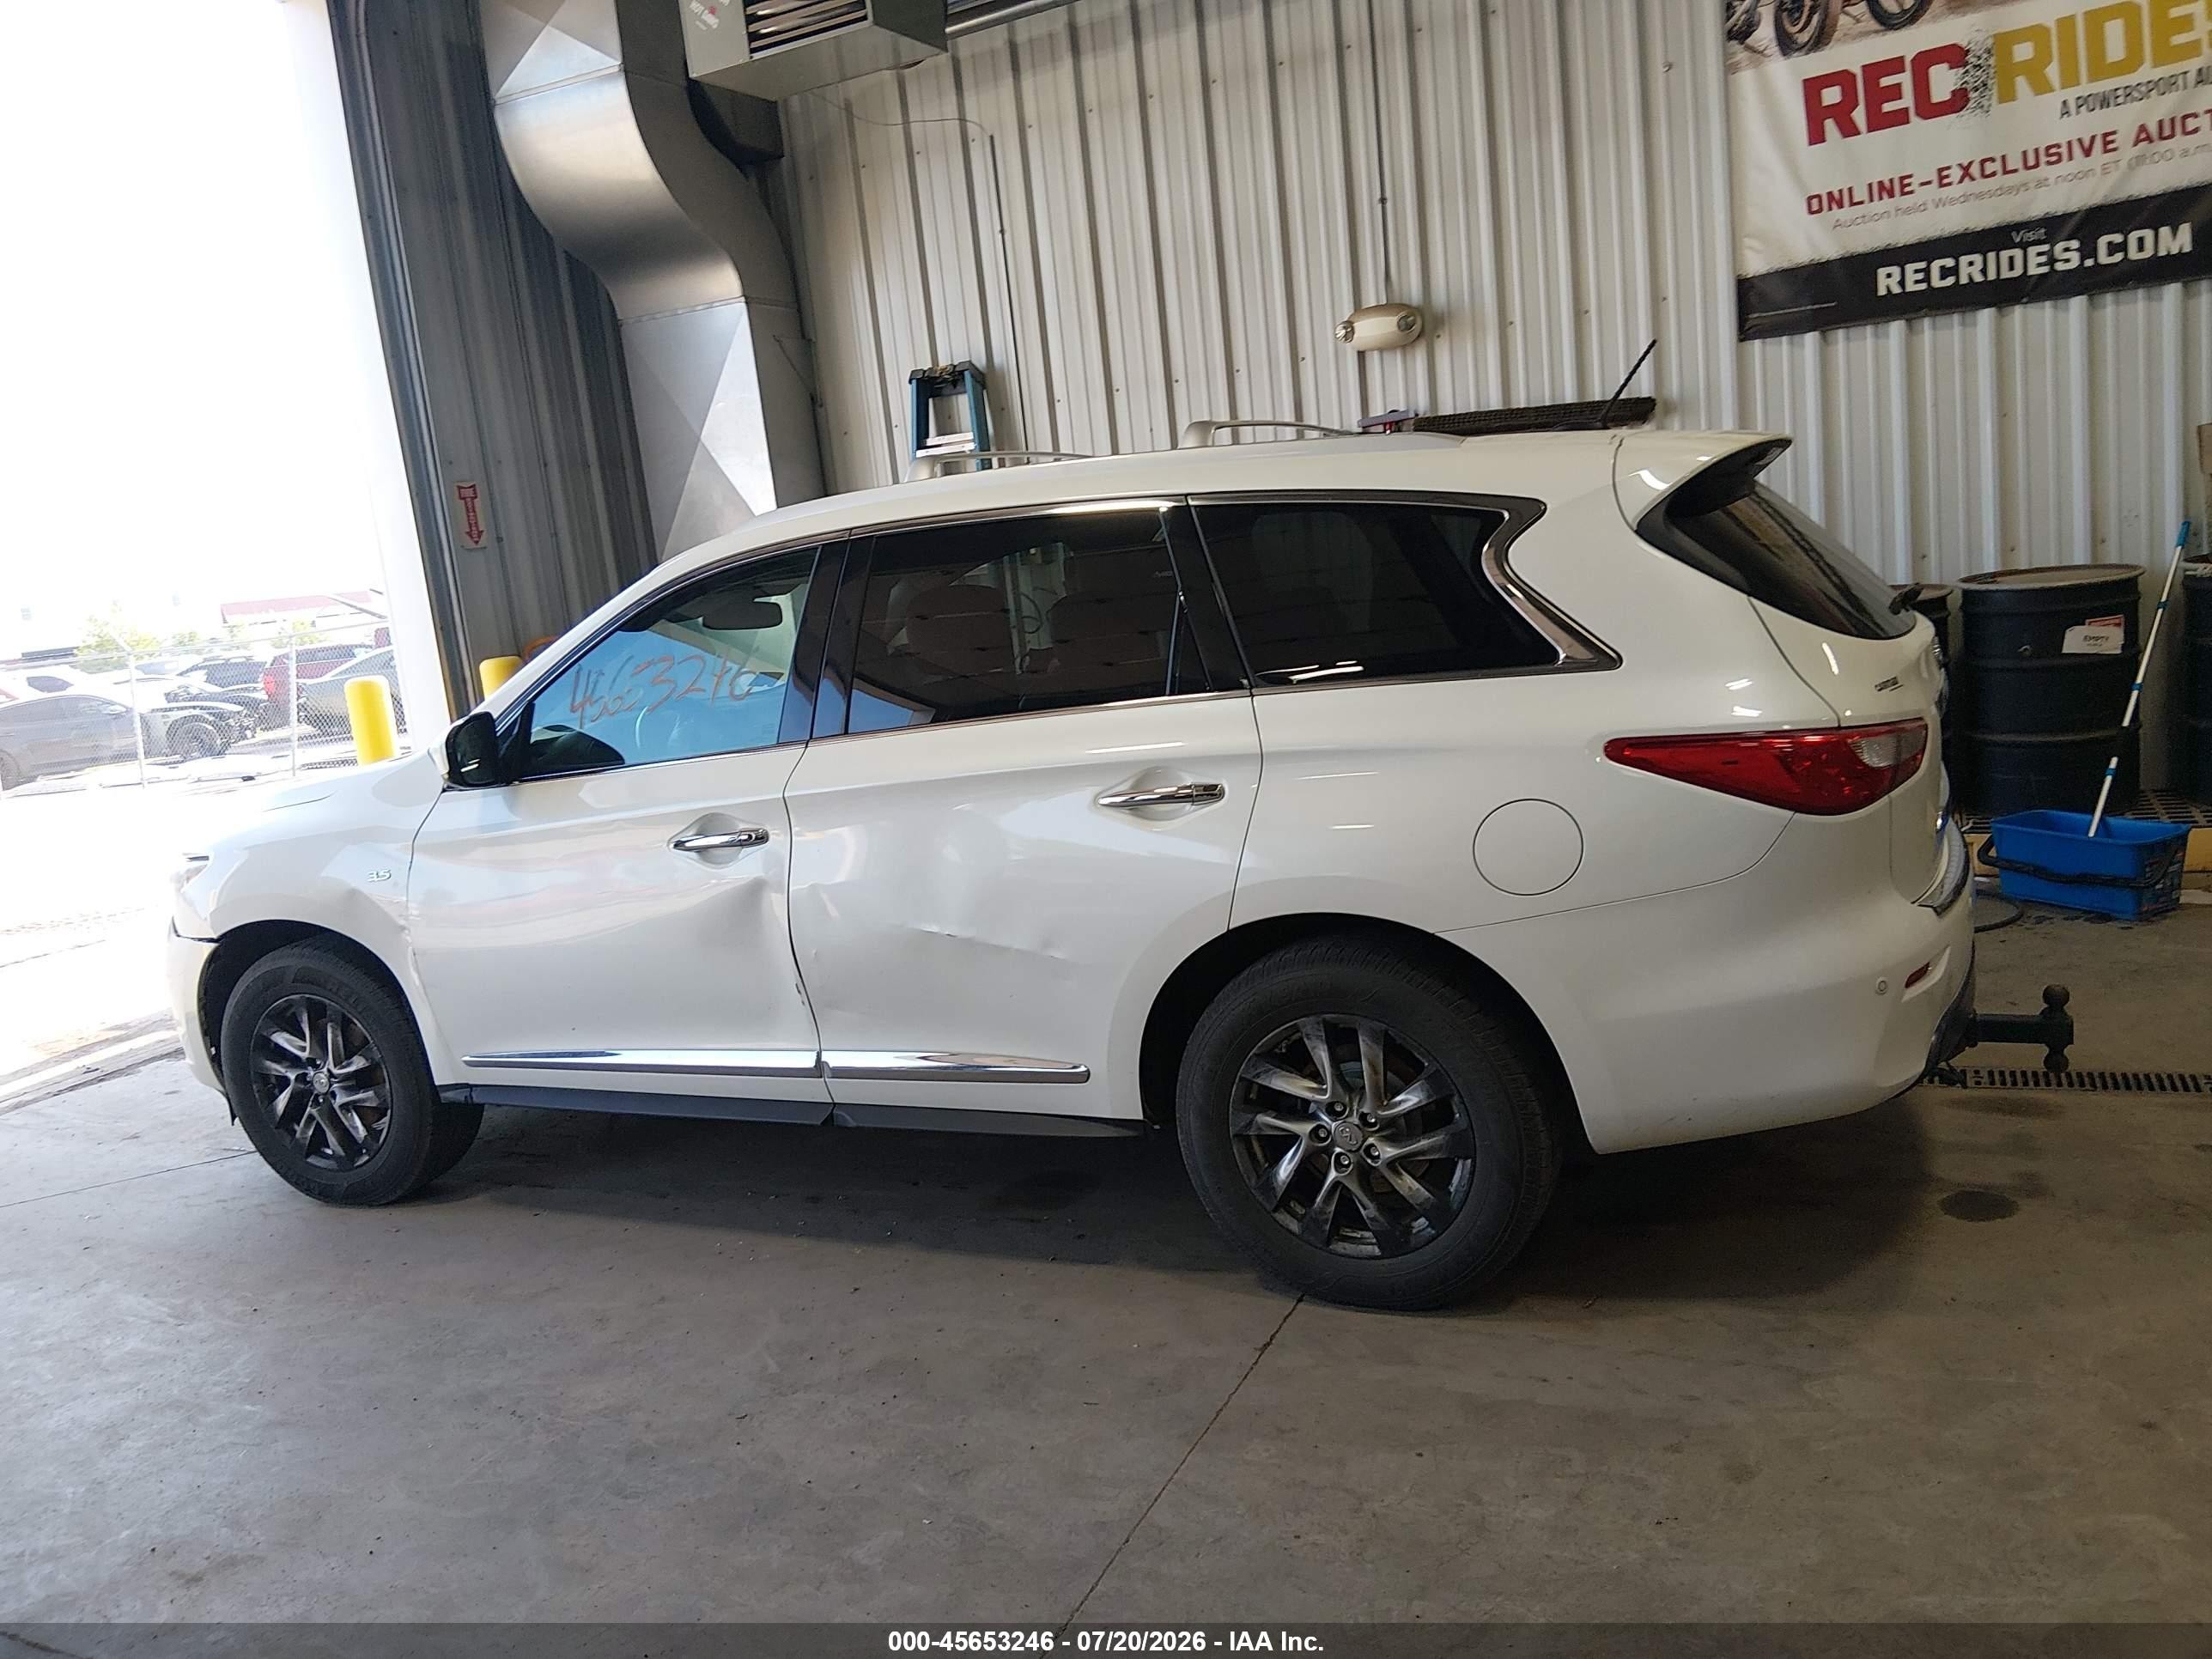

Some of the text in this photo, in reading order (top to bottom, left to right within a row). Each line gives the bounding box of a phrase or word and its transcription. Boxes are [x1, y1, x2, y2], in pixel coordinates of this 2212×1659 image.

[1802, 0, 2212, 146] REC RIDE
[2059, 99, 2071, 119] A
[2075, 70, 2190, 116] POWERSPORT
[1806, 130, 2119, 215] ONLINE-EXCLUSIVE
[1832, 209, 1892, 231] Auction
[1894, 199, 1929, 217] held
[1932, 179, 2029, 209] Wednesdays
[2011, 227, 2047, 243] Visit
[1876, 222, 2192, 296] RECRIDES.COM
